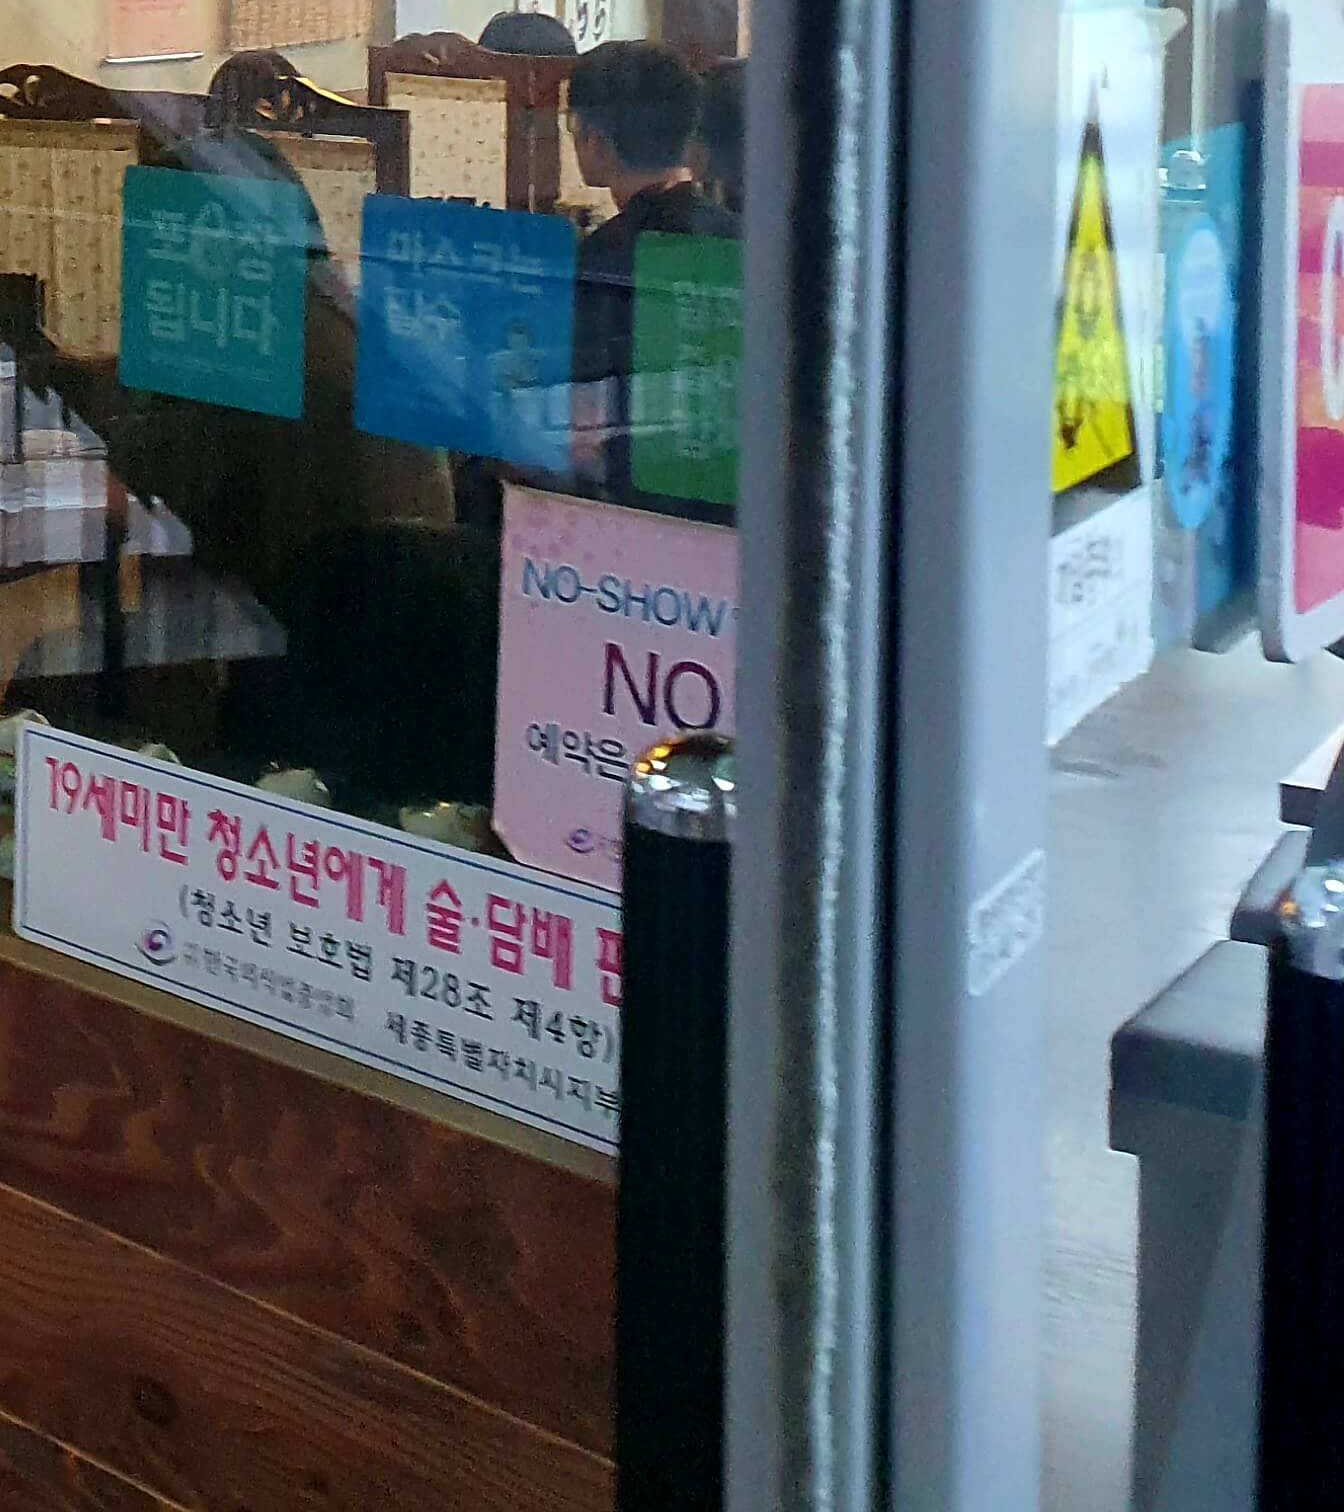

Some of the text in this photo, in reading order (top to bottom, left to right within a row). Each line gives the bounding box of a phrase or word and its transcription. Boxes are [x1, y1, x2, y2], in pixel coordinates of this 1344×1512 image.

[385, 231, 545, 296] 마스크는
[145, 280, 276, 356] 됩니다
[521, 556, 728, 638] NO-SHOW
[602, 641, 721, 730] NO
[525, 722, 631, 784] 예약은
[45, 756, 192, 866] 19세미만
[207, 808, 407, 936] 청소년에게
[179, 884, 614, 1064] (청소년 보호법 제28조 제4항)
